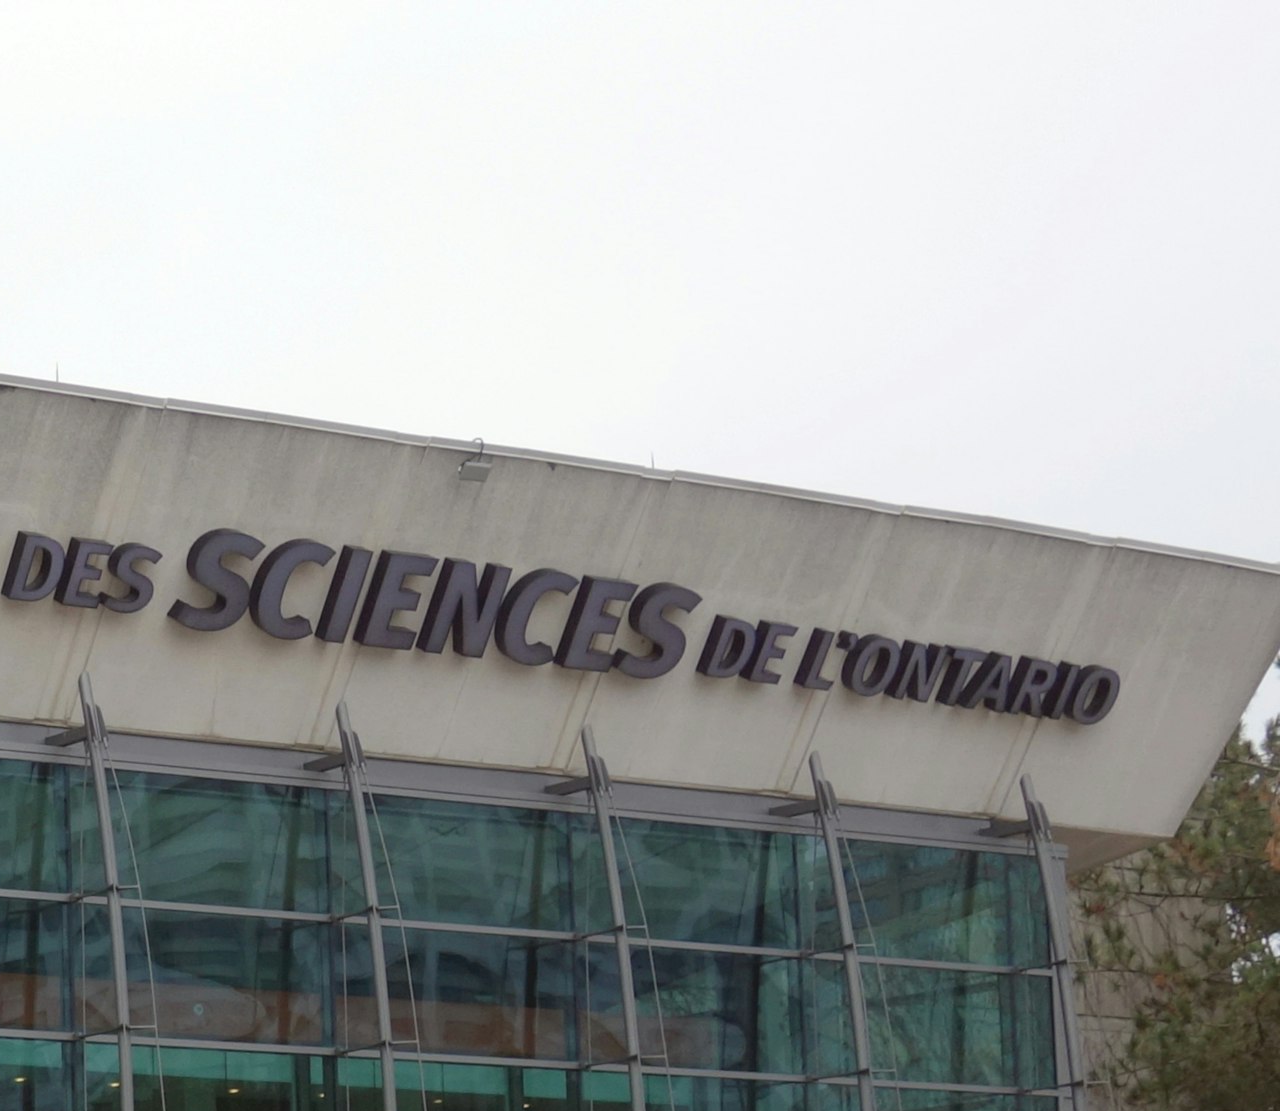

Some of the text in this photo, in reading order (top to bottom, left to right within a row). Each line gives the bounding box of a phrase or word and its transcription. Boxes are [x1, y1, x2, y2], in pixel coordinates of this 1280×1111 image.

[1, 529, 163, 614] DES
[167, 527, 703, 679] SCIENCES
[695, 614, 799, 685] DE
[794, 627, 1122, 726] L'ONTARIO
